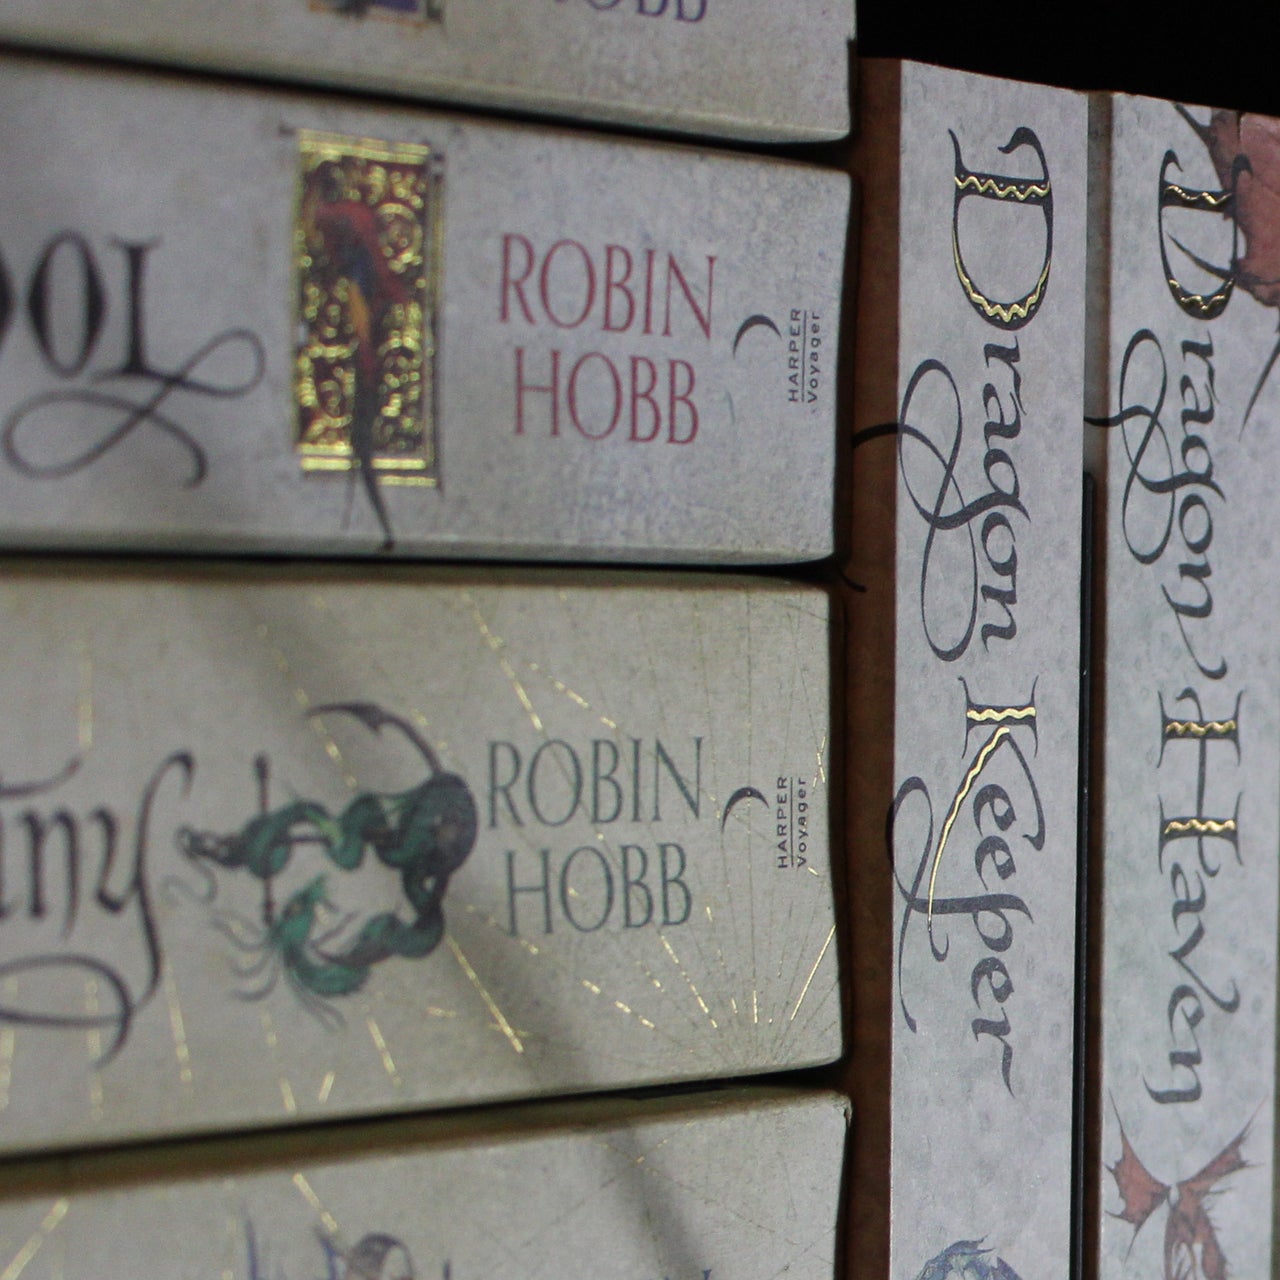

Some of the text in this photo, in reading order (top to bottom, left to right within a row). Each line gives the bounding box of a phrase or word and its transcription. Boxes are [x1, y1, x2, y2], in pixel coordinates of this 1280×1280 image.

[498, 233, 717, 339] ROBIN
[514, 346, 701, 445] HOBB
[787, 308, 801, 402] HARPER
[807, 311, 821, 403] Voyager
[888, 127, 1054, 1098] Dragon Keeper
[1088, 149, 1253, 1105] Dragon Haven
[486, 736, 704, 829] ROBIN
[776, 775, 788, 869] HARPER
[795, 776, 809, 869] Voyager
[506, 843, 693, 936] HOBB
